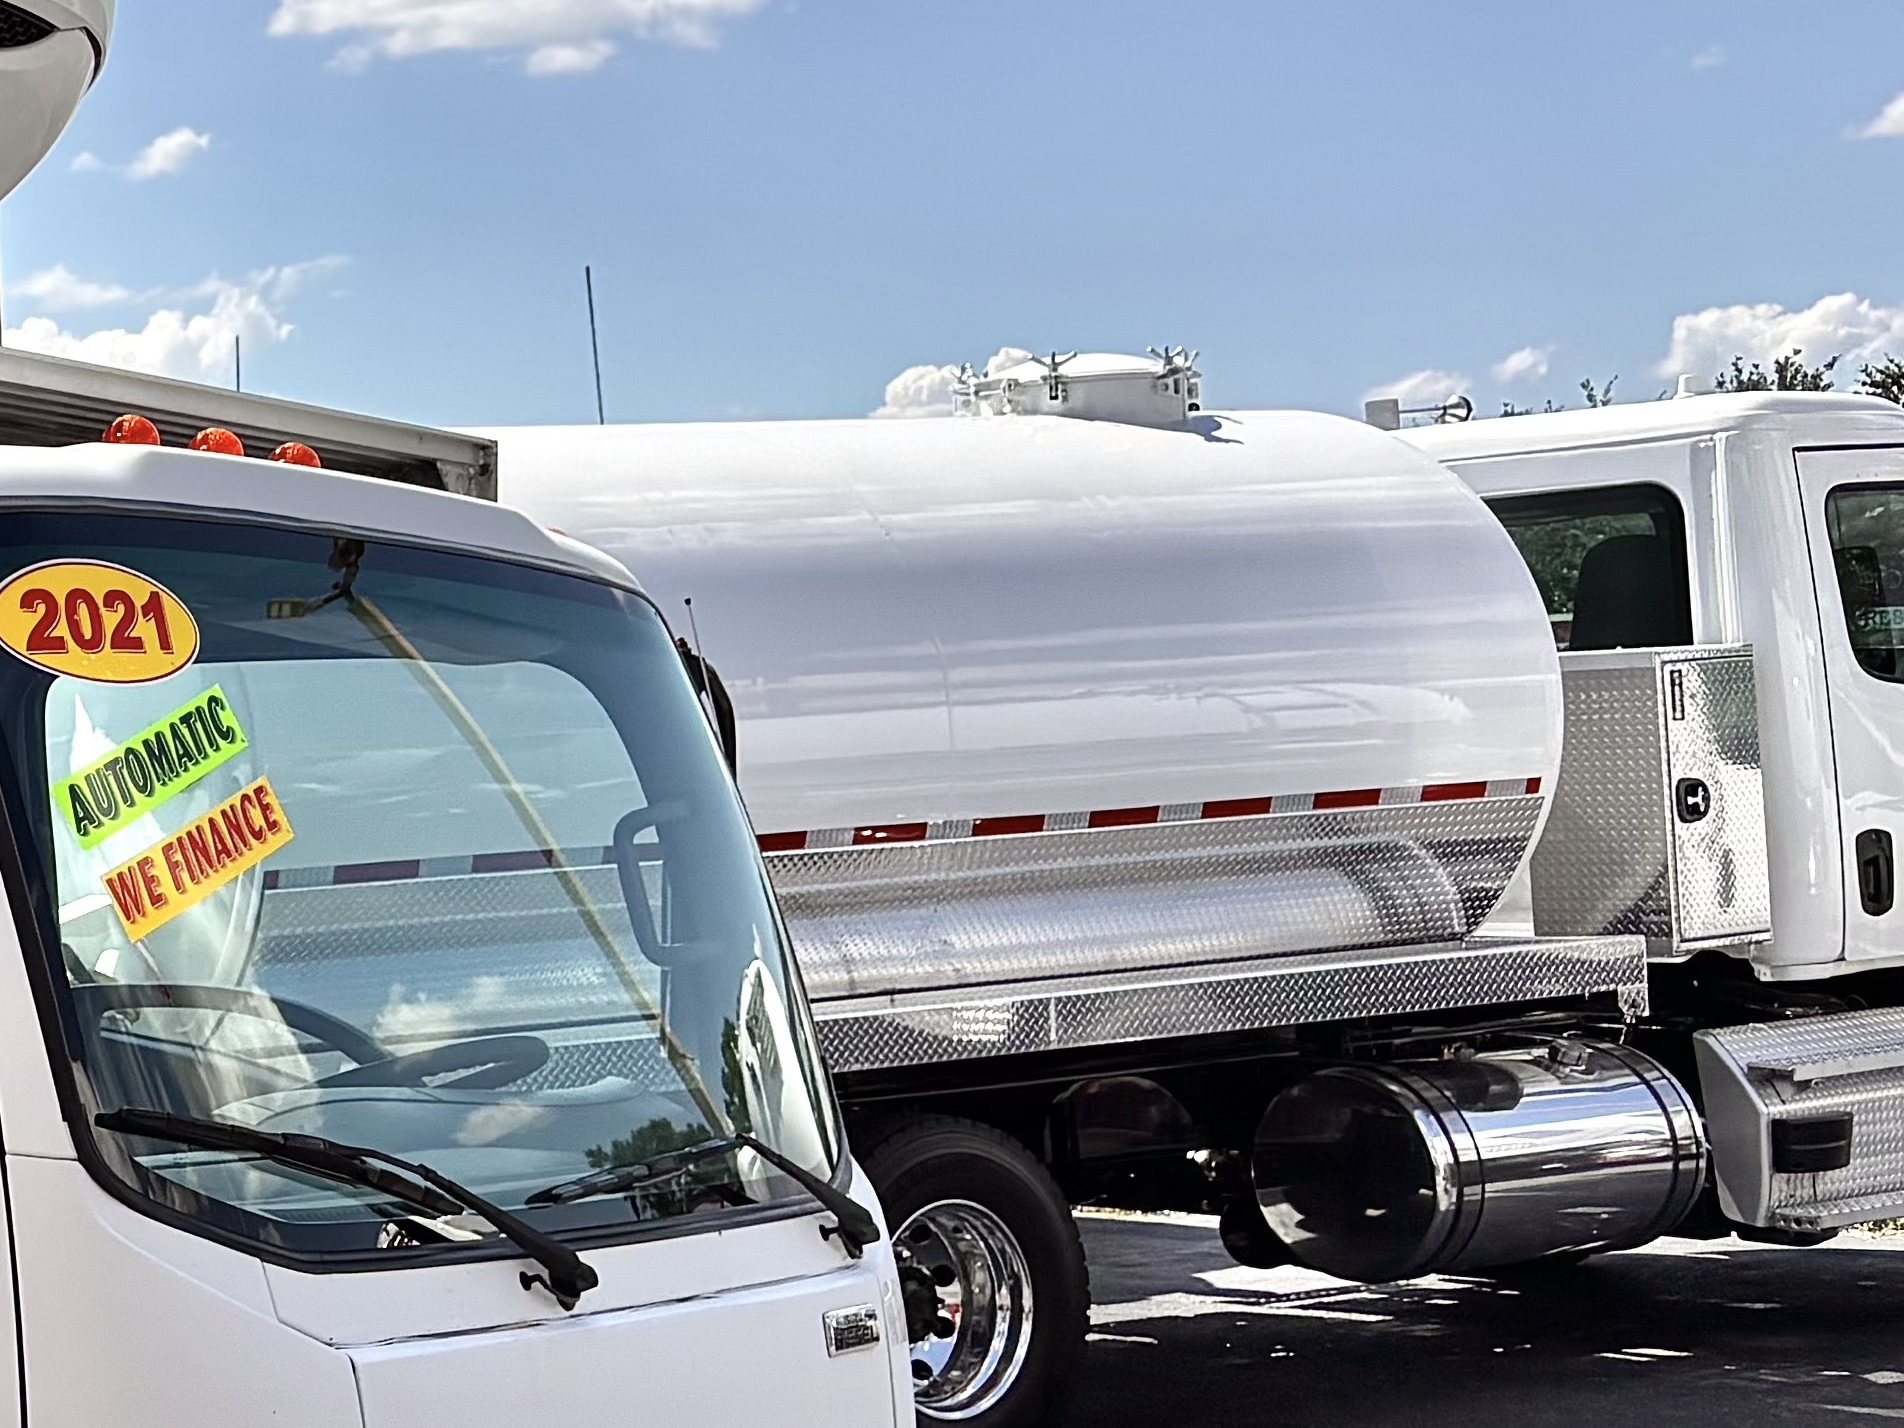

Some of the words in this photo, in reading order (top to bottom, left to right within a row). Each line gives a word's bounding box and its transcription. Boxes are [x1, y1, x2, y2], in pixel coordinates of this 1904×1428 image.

[19, 587, 175, 655] 2021
[67, 694, 237, 838] AUTOMATIC
[105, 856, 167, 926] WE
[161, 784, 283, 895] FINANCE
